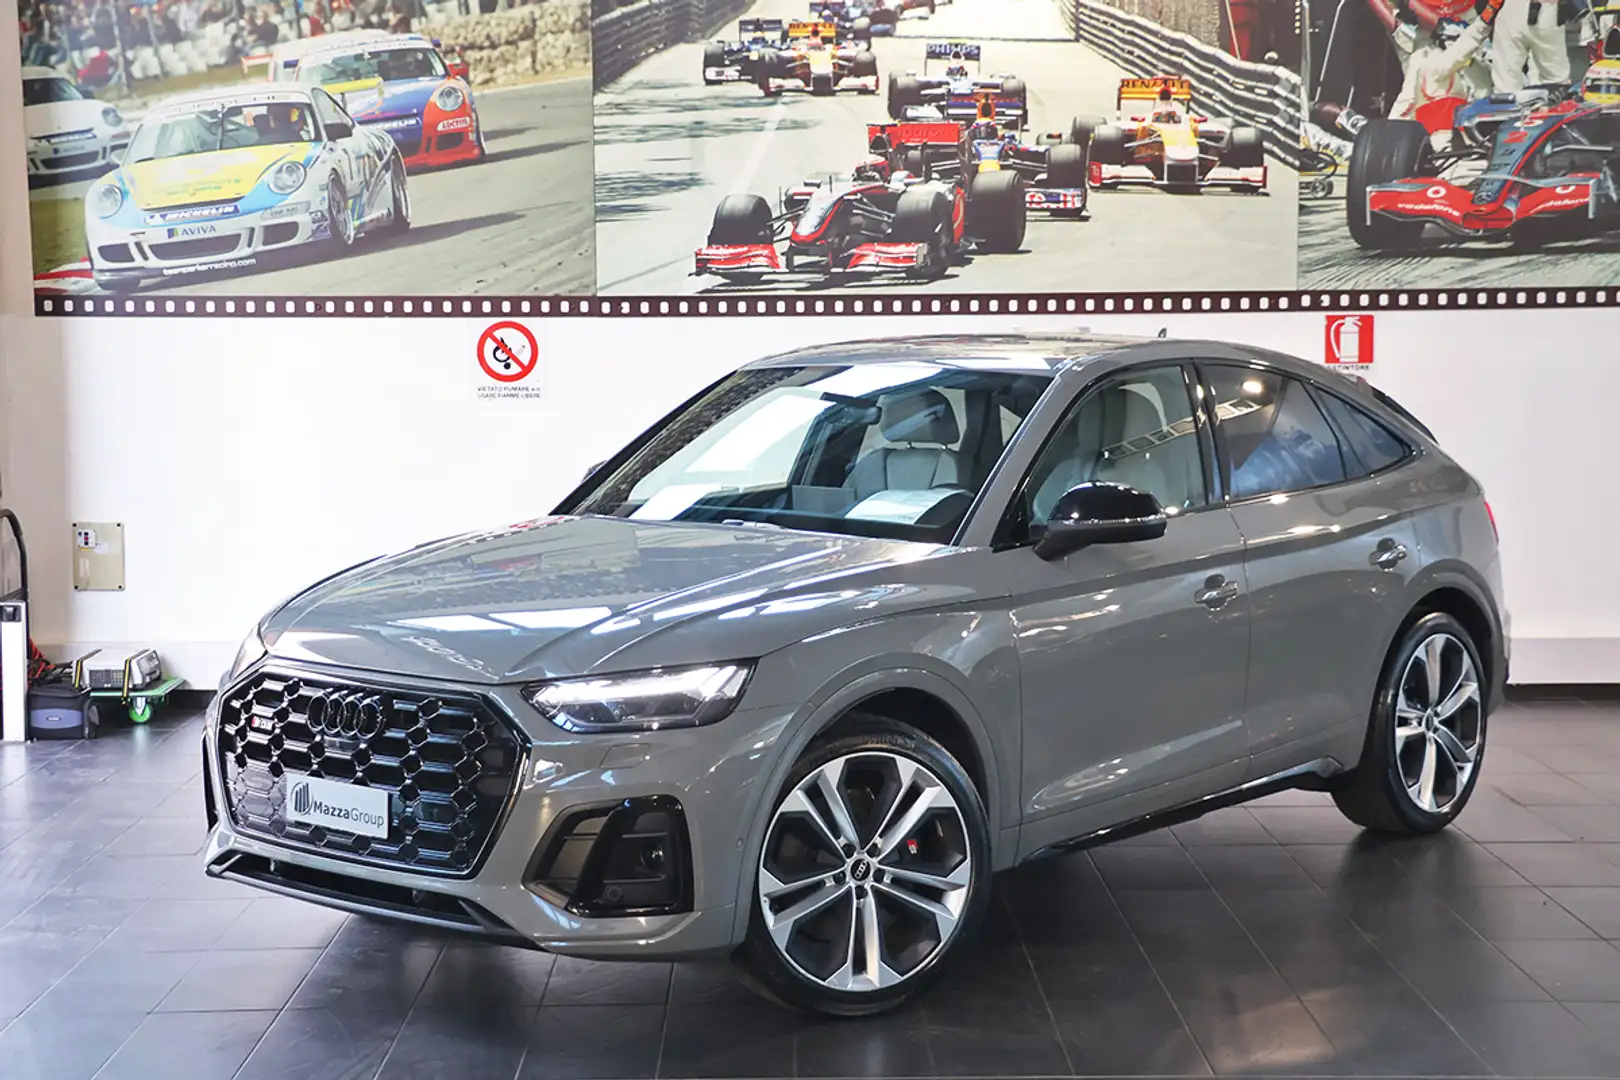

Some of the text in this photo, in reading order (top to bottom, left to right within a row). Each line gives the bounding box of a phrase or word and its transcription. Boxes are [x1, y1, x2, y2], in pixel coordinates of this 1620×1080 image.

[927, 44, 978, 54] PHIPS
[1121, 80, 1187, 89] RENALT
[1397, 203, 1460, 216] vodafone
[181, 225, 216, 236] AVIVA
[313, 801, 384, 828] MazzaGroup
